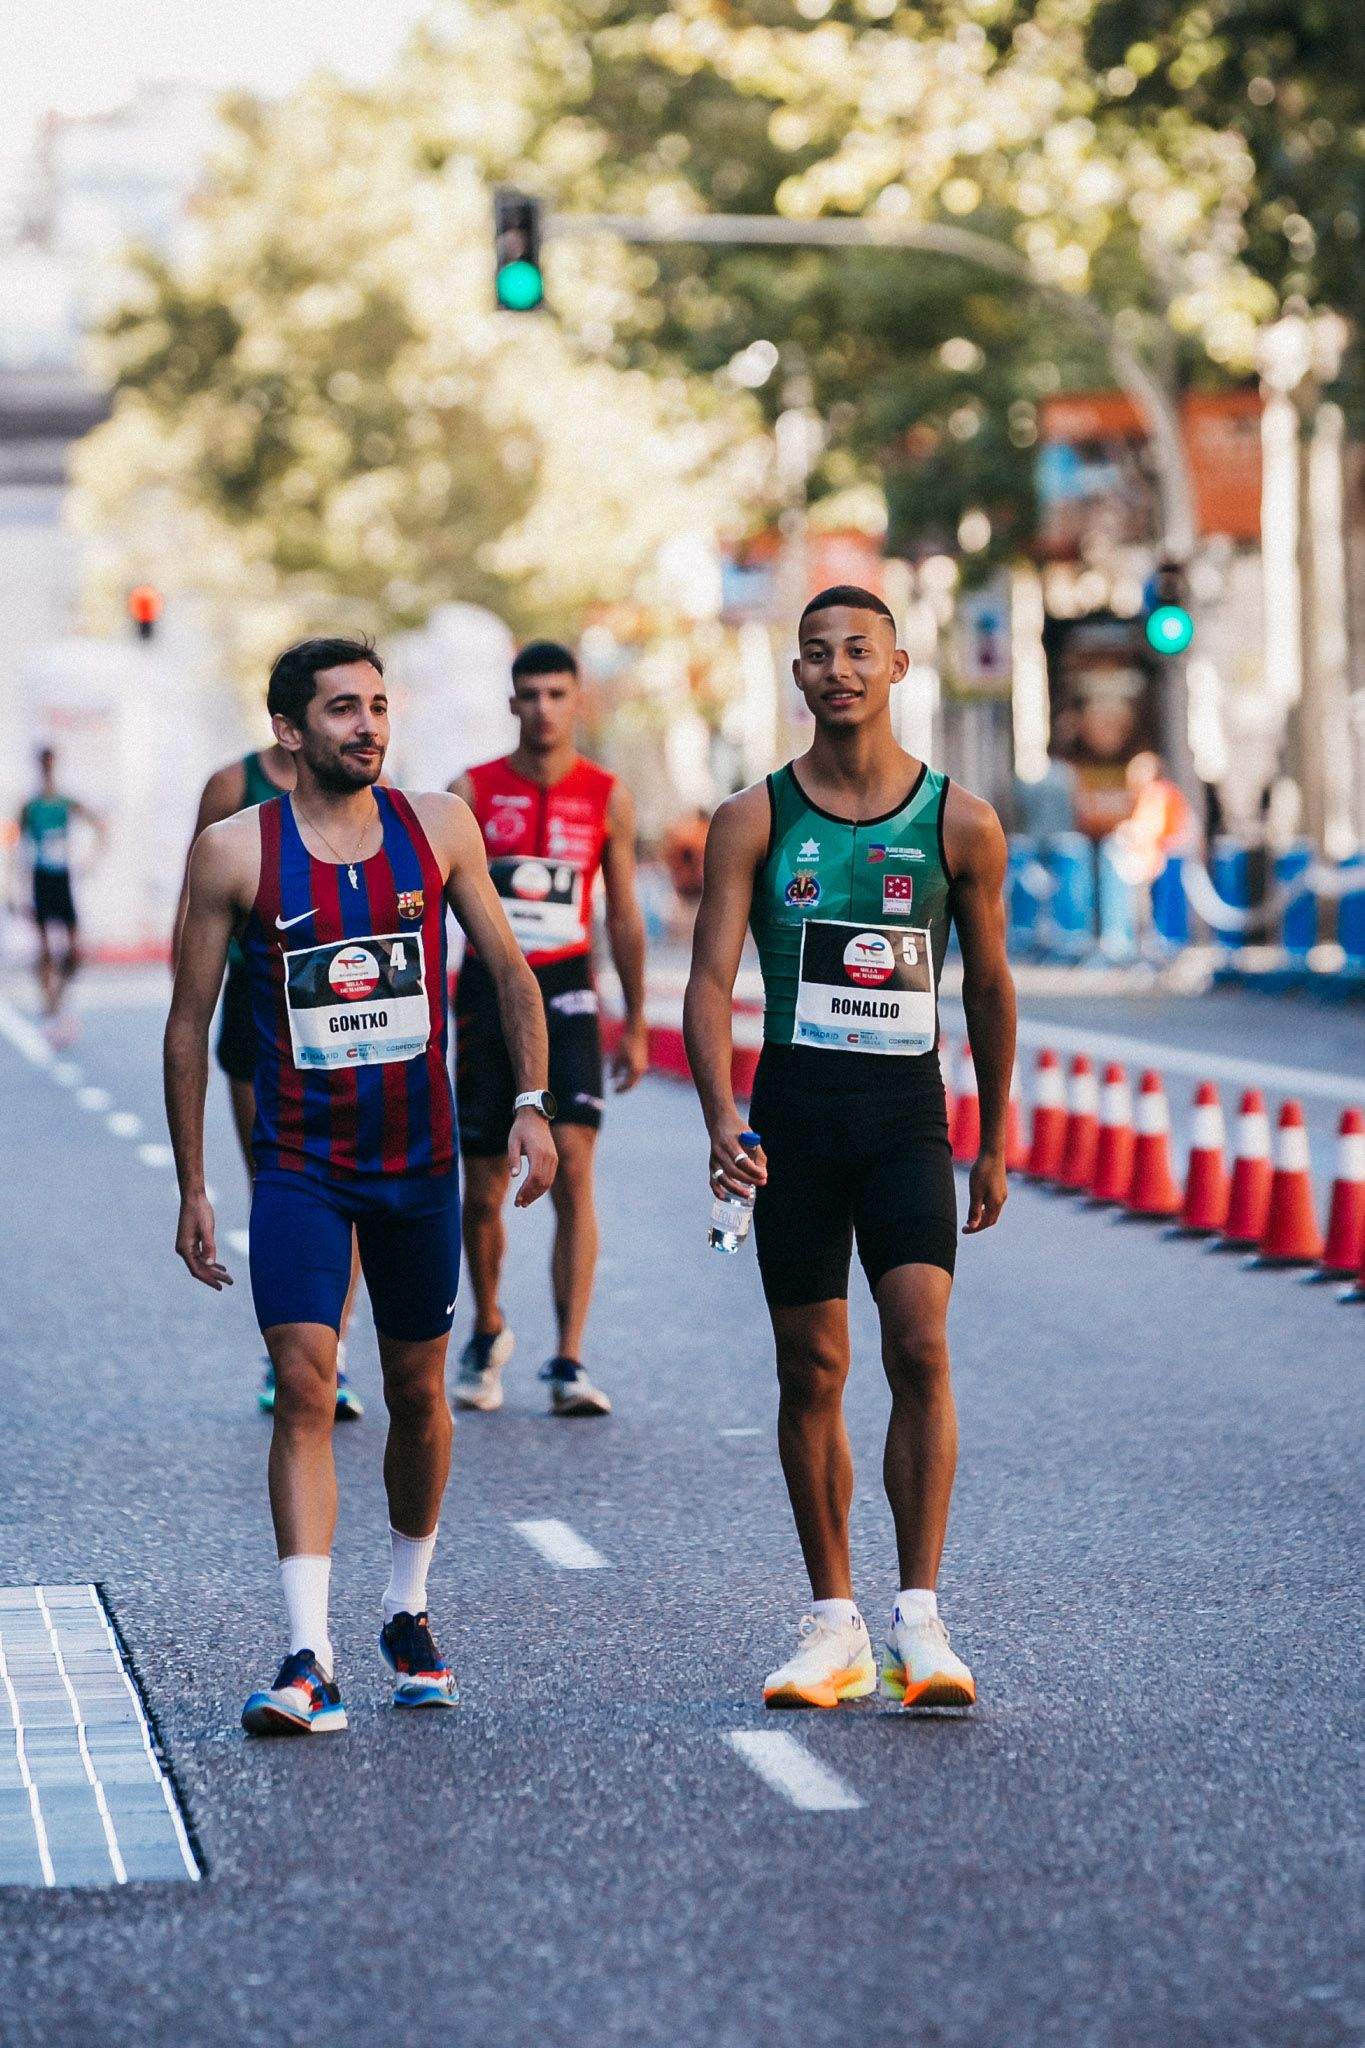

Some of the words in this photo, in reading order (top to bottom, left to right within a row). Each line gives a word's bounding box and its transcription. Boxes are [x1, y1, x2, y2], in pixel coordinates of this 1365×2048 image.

[390, 942, 407, 971] 4
[902, 936, 918, 966] 5
[830, 997, 900, 1019] RONALDO
[329, 1010, 388, 1033] GONTXO
[810, 1030, 839, 1040] MADRID
